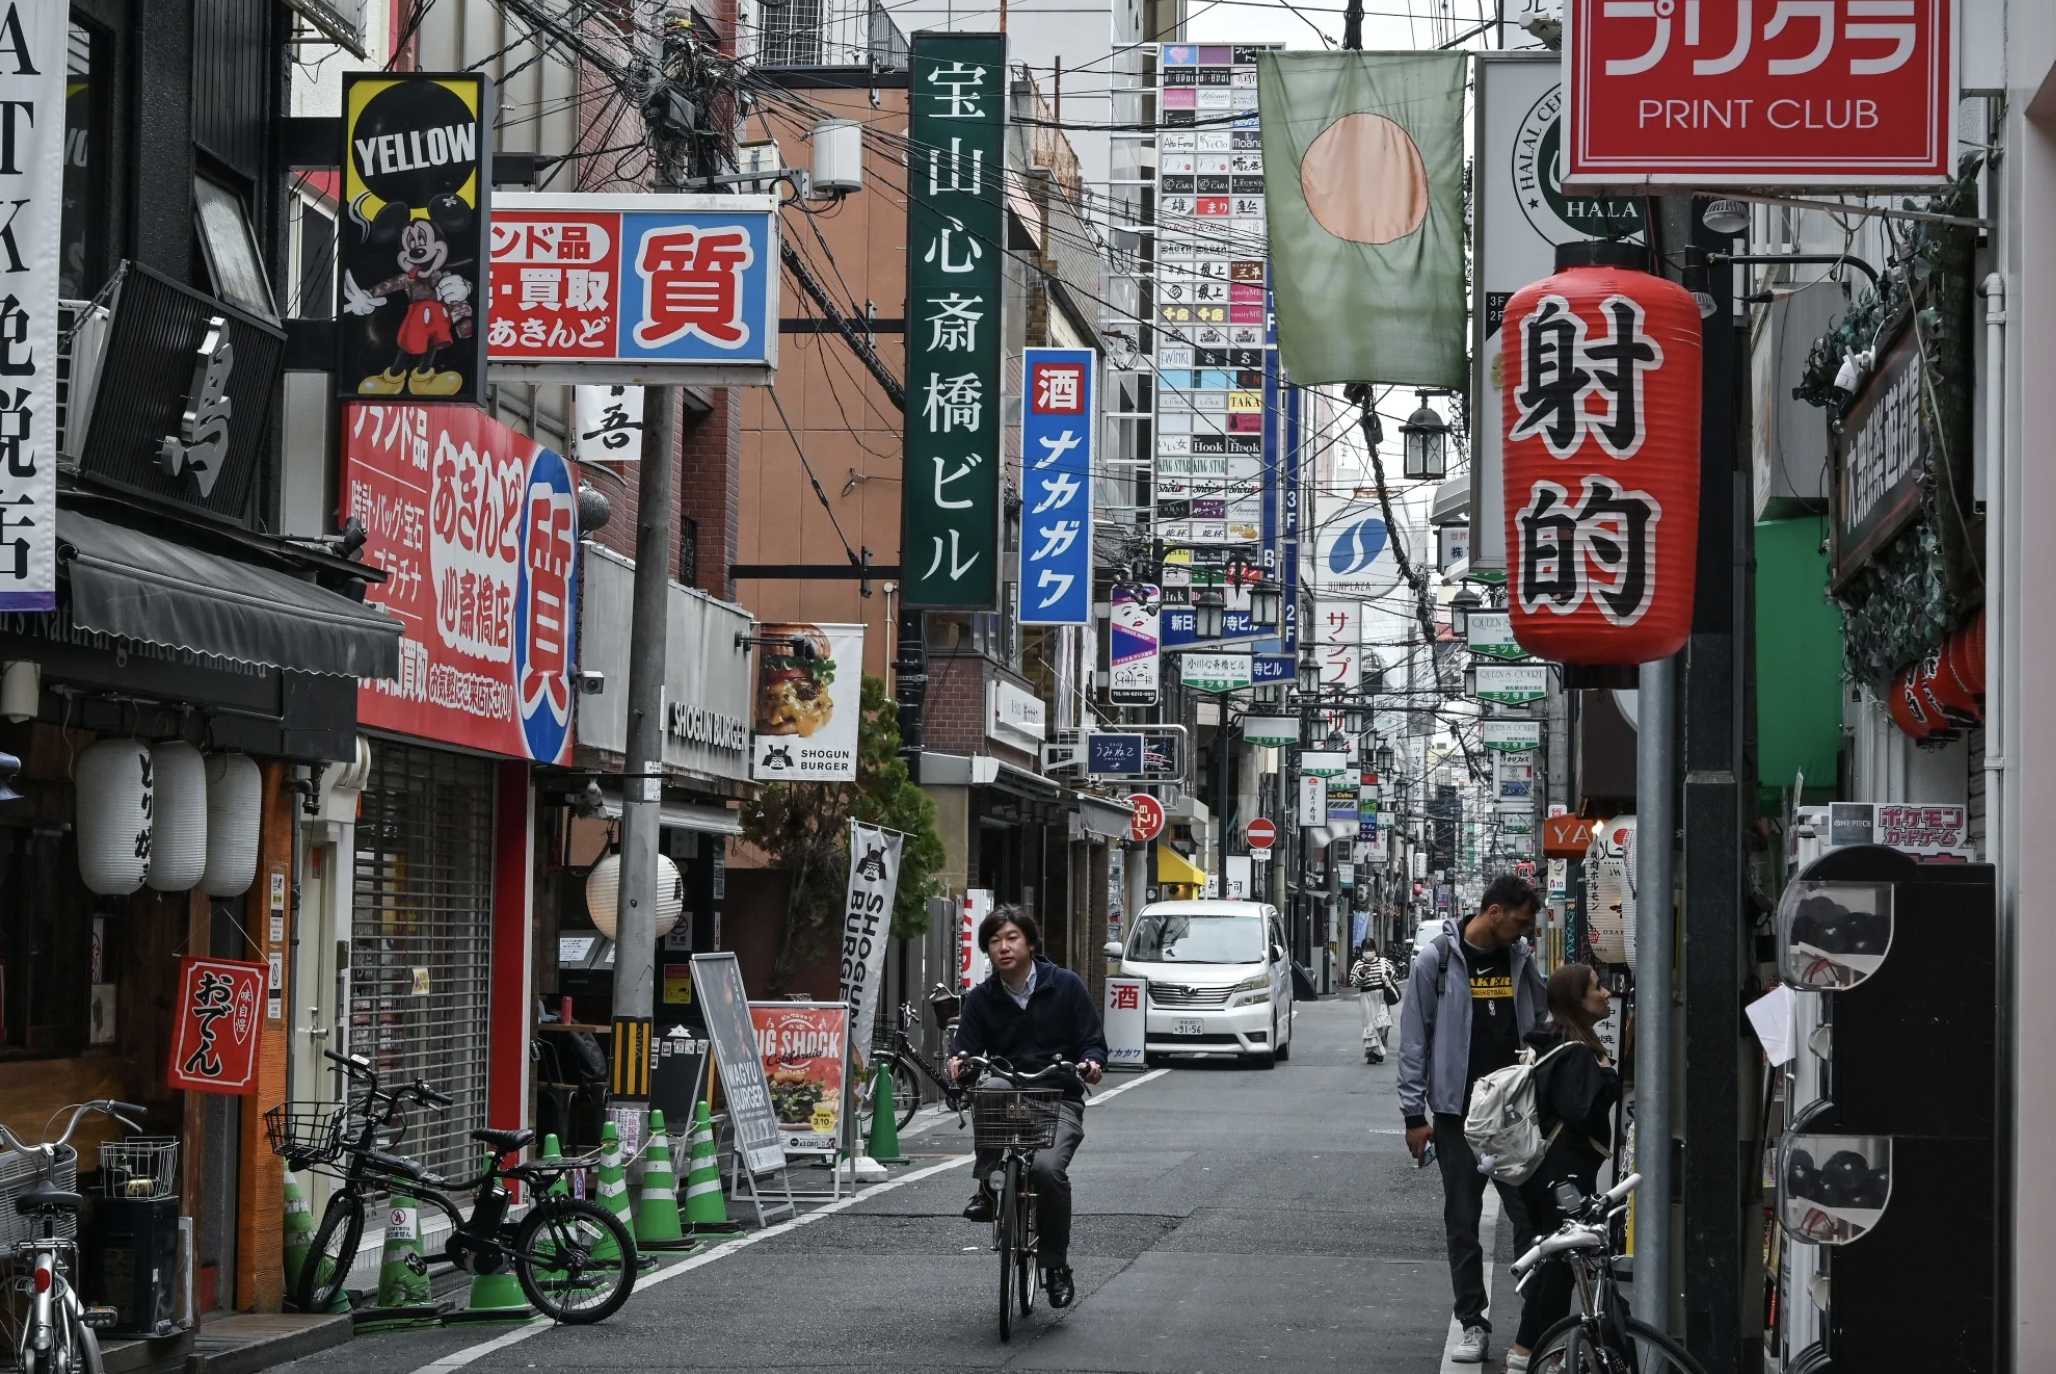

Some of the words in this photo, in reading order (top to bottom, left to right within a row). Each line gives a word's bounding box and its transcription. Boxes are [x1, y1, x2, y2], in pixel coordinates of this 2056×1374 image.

[1639, 99, 1753, 129] PRINT
[1767, 99, 1880, 130] CLUB
[355, 122, 477, 177] YELLOW
[1518, 126, 1542, 191] HALAL
[1171, 198, 1187, 212] 雄
[1207, 201, 1228, 214] まり
[1566, 201, 1639, 218] HALA
[634, 224, 755, 349] 質
[1236, 266, 1262, 280] 三平
[488, 317, 610, 349] あきんど
[920, 61, 987, 595] 宝山心斎橋ビル
[1036, 367, 1080, 411] 酒
[1194, 441, 1223, 452] Hook
[1230, 441, 1260, 453] Hook
[1508, 295, 1665, 628] 射的
[433, 438, 525, 565] あきんど
[1286, 491, 1297, 529] 3F
[1029, 430, 1083, 609] ナカガク
[439, 566, 513, 652] 心斎橋店
[520, 482, 576, 728] 質
[1162, 590, 1185, 602] ink
[1171, 613, 1260, 632] 新日寺ビル
[1285, 604, 1297, 642] 2F
[1488, 644, 1521, 654] 三ツ寺
[674, 701, 714, 744] SHOGUN
[713, 711, 748, 752] BURGER
[800, 761, 849, 772] BURGER
[801, 749, 850, 760] SHOGUN
[1833, 819, 1851, 828] ONE
[1851, 819, 1872, 828] PIECE
[1879, 806, 1964, 830] ポケモン
[1882, 829, 1959, 848] カードゲーム
[235, 989, 252, 1033] 味自慢
[1109, 983, 1140, 1010] 酒
[183, 970, 235, 1078] おでん
[753, 1028, 777, 1057] IG
[781, 1030, 841, 1059] SHOCK
[766, 1047, 824, 1067] California
[725, 1060, 759, 1088] WAGYU
[733, 1084, 766, 1113] BURGER
